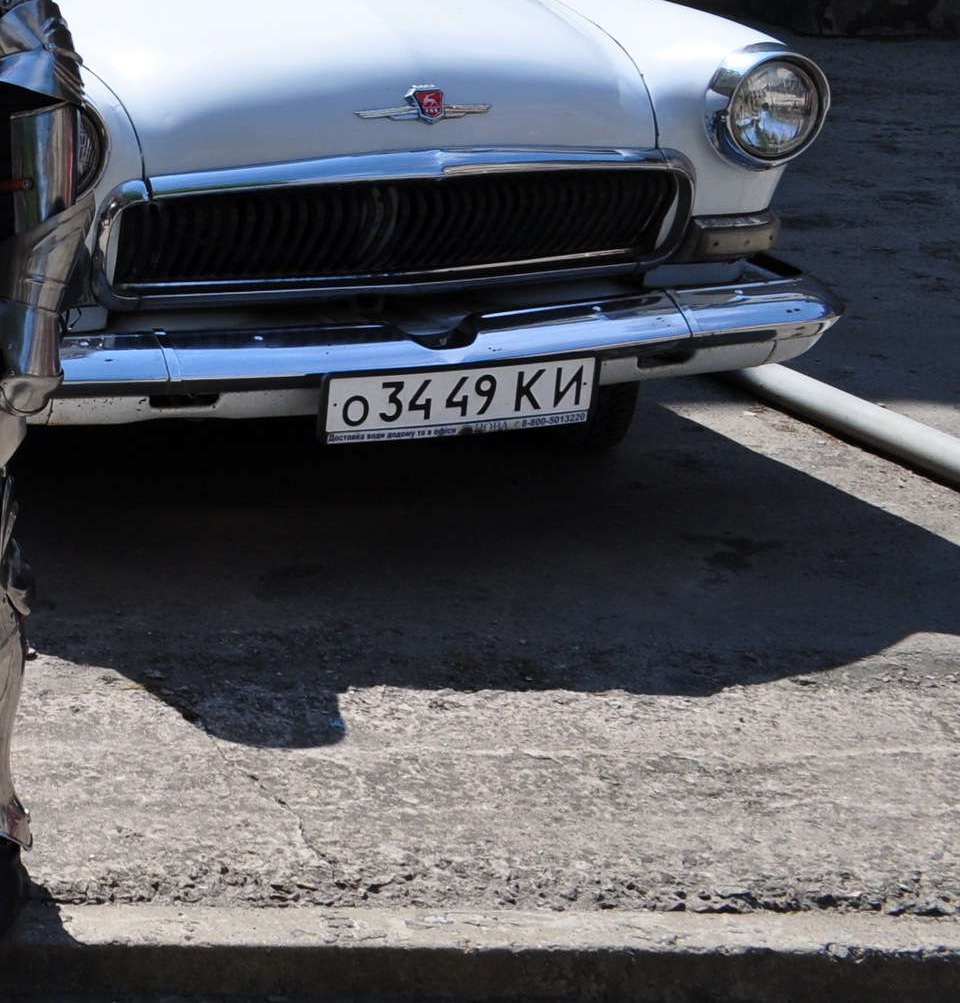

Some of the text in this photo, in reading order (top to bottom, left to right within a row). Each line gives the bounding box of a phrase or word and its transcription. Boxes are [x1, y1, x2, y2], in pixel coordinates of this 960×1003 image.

[328, 433, 365, 443] Доставка
[366, 432, 385, 440] води
[386, 430, 416, 439] додому
[417, 429, 426, 437] та
[521, 412, 586, 428] 8-800-5013220
